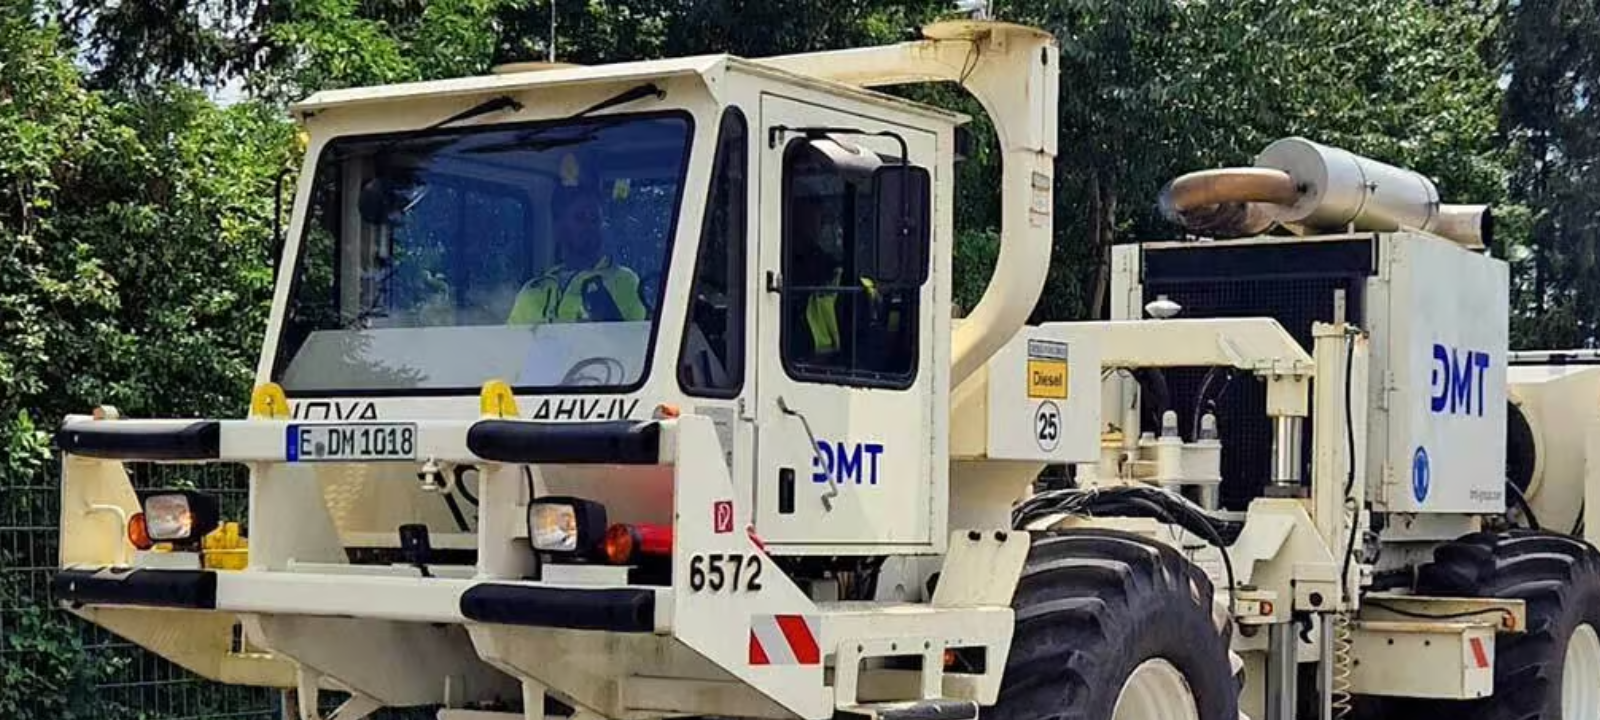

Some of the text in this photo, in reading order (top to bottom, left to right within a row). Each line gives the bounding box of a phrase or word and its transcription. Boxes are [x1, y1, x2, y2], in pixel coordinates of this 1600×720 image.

[1033, 370, 1063, 387] Diesel
[1431, 343, 1490, 417] DMT
[532, 399, 640, 419] AHV-IV
[1039, 412, 1058, 440] 25
[300, 429, 312, 455] E
[328, 429, 355, 455] DM
[360, 427, 413, 455] 1018
[812, 441, 883, 485] DMT
[690, 554, 762, 591] 6572
